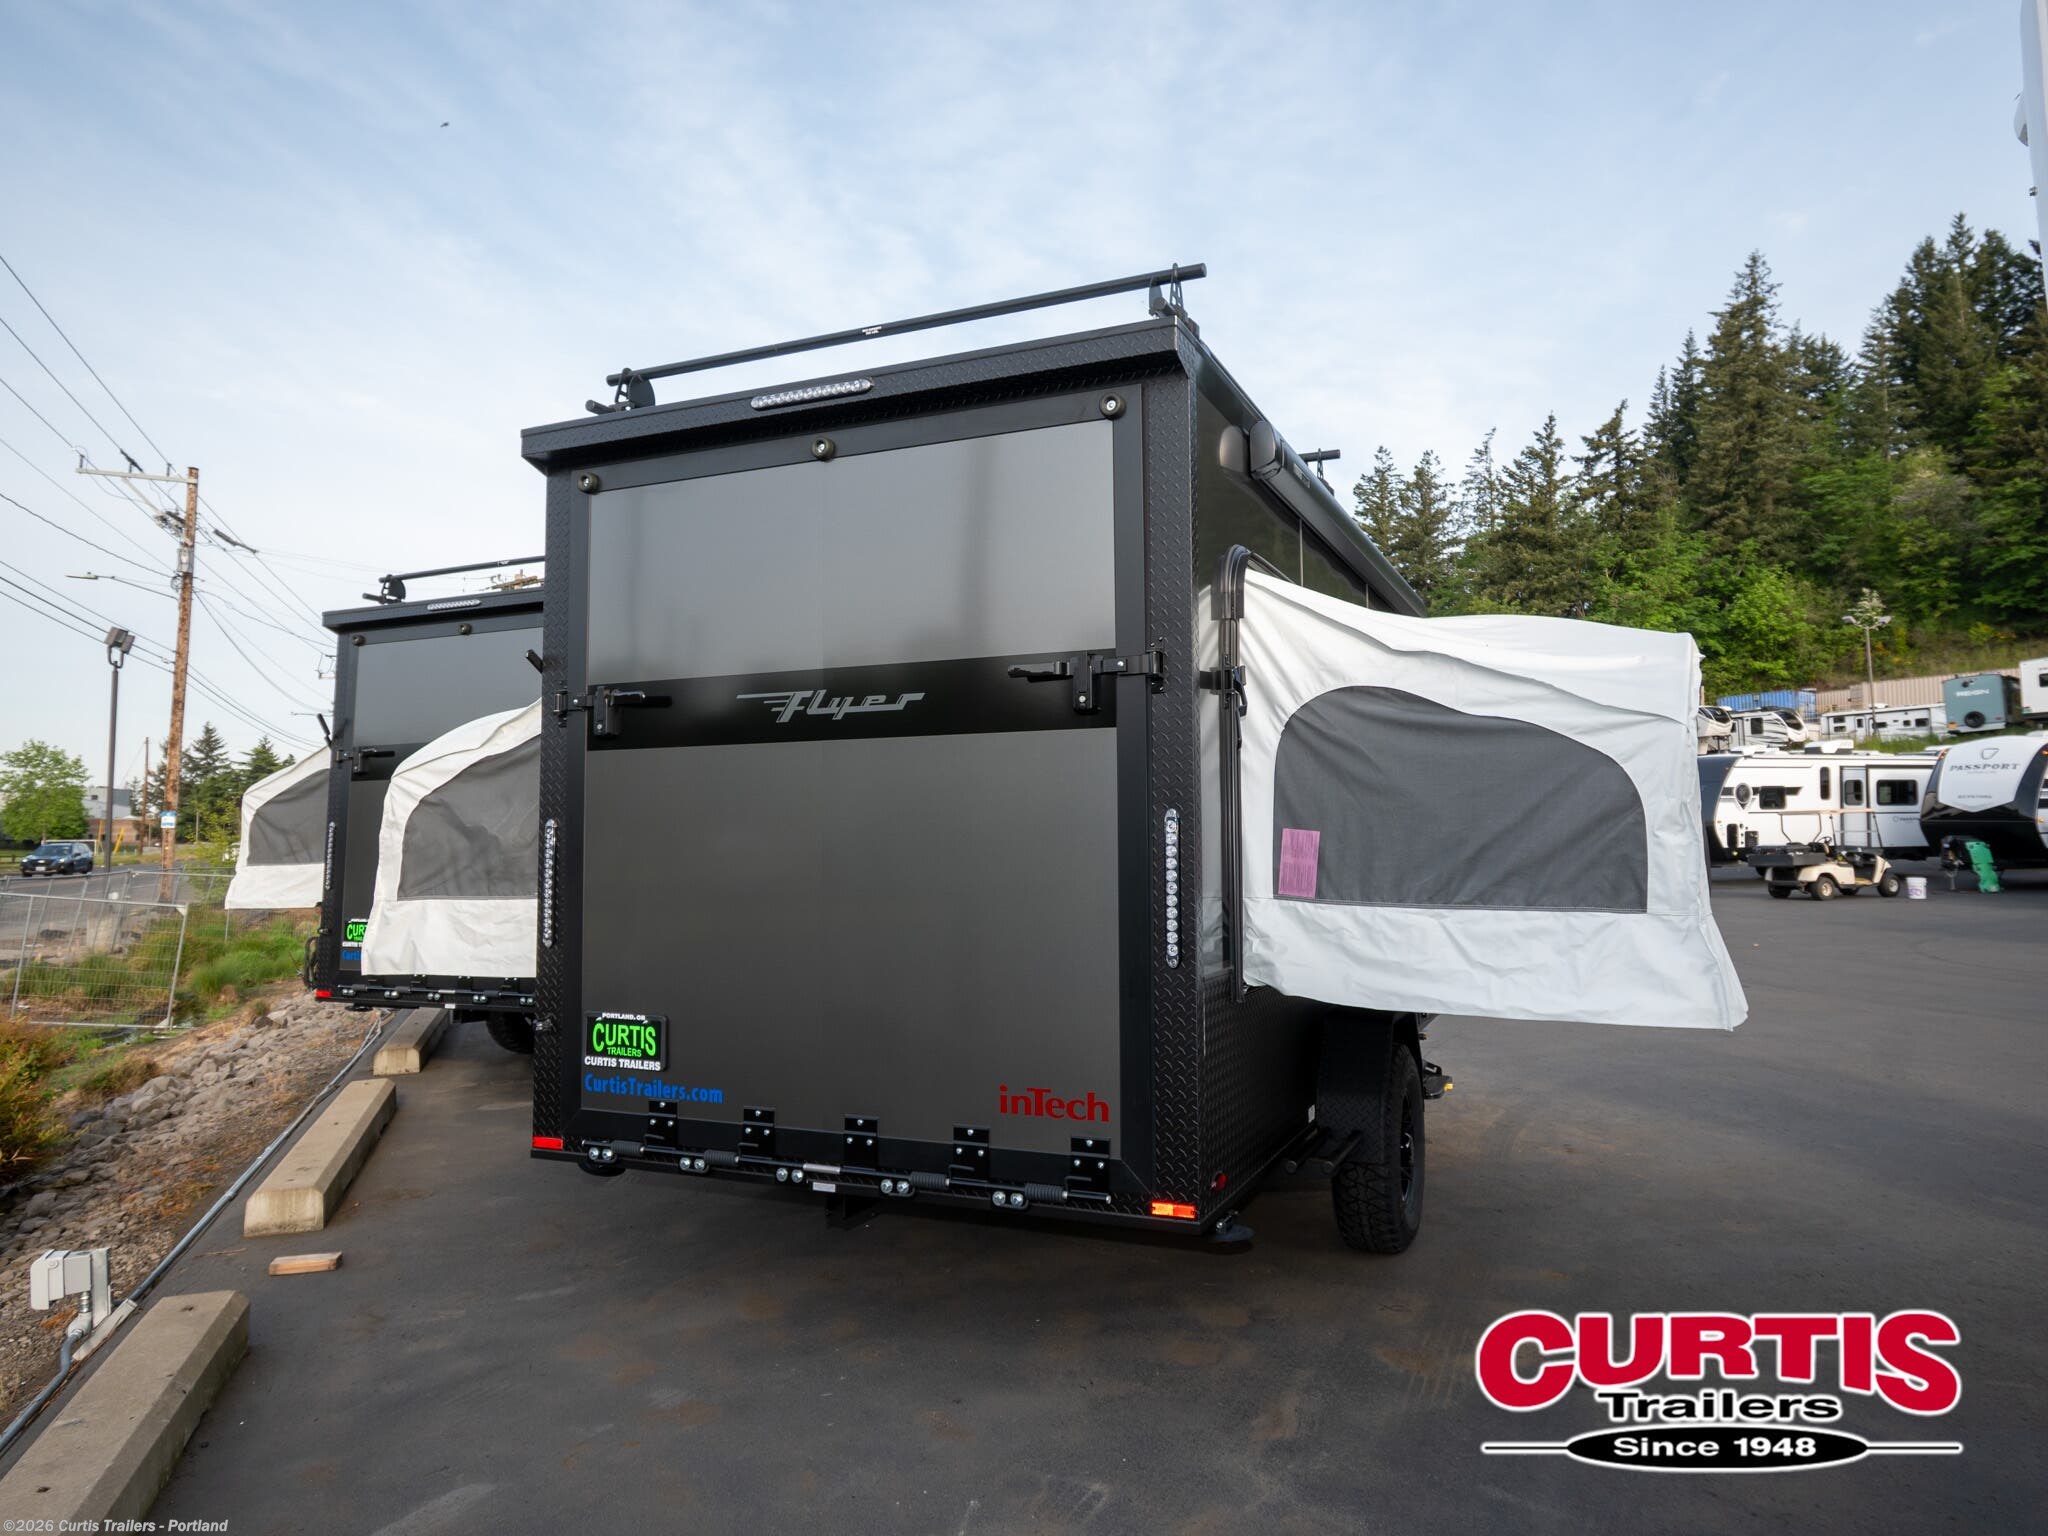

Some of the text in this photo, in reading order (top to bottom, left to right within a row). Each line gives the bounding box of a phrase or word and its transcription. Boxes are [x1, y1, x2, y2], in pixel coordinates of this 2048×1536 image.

[736, 689, 925, 723] Flyer
[1950, 763, 2020, 771] PASSPORT
[593, 1023, 656, 1056] CURTIS
[607, 1047, 642, 1057] TRAILERS
[584, 1056, 661, 1071] CURTIS TRAILERS
[584, 1074, 723, 1103] CurtisTrailers.com
[999, 1085, 1109, 1122] inTech
